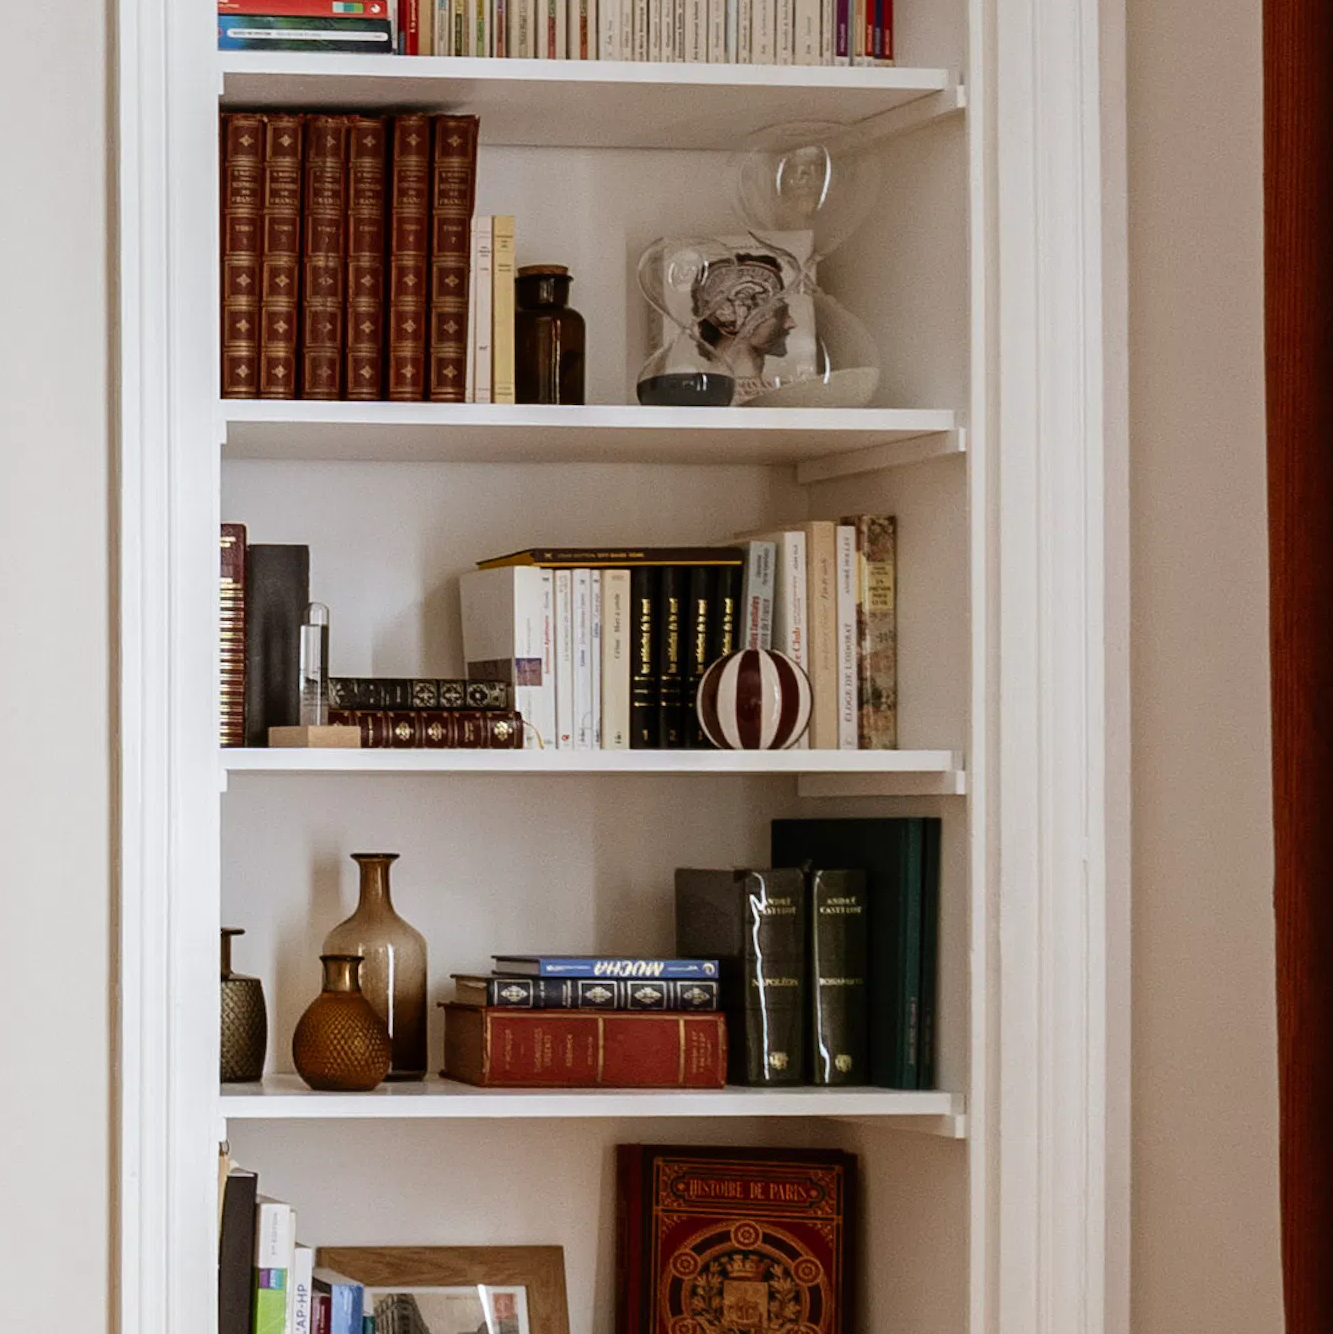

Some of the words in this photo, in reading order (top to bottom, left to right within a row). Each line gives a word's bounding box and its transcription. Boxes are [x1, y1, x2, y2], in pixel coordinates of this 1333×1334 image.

[593, 960, 665, 977] MUCHA
[688, 1178, 744, 1199] HISTOIRE
[749, 1181, 765, 1199] DE
[769, 1182, 808, 1201] PARIS
